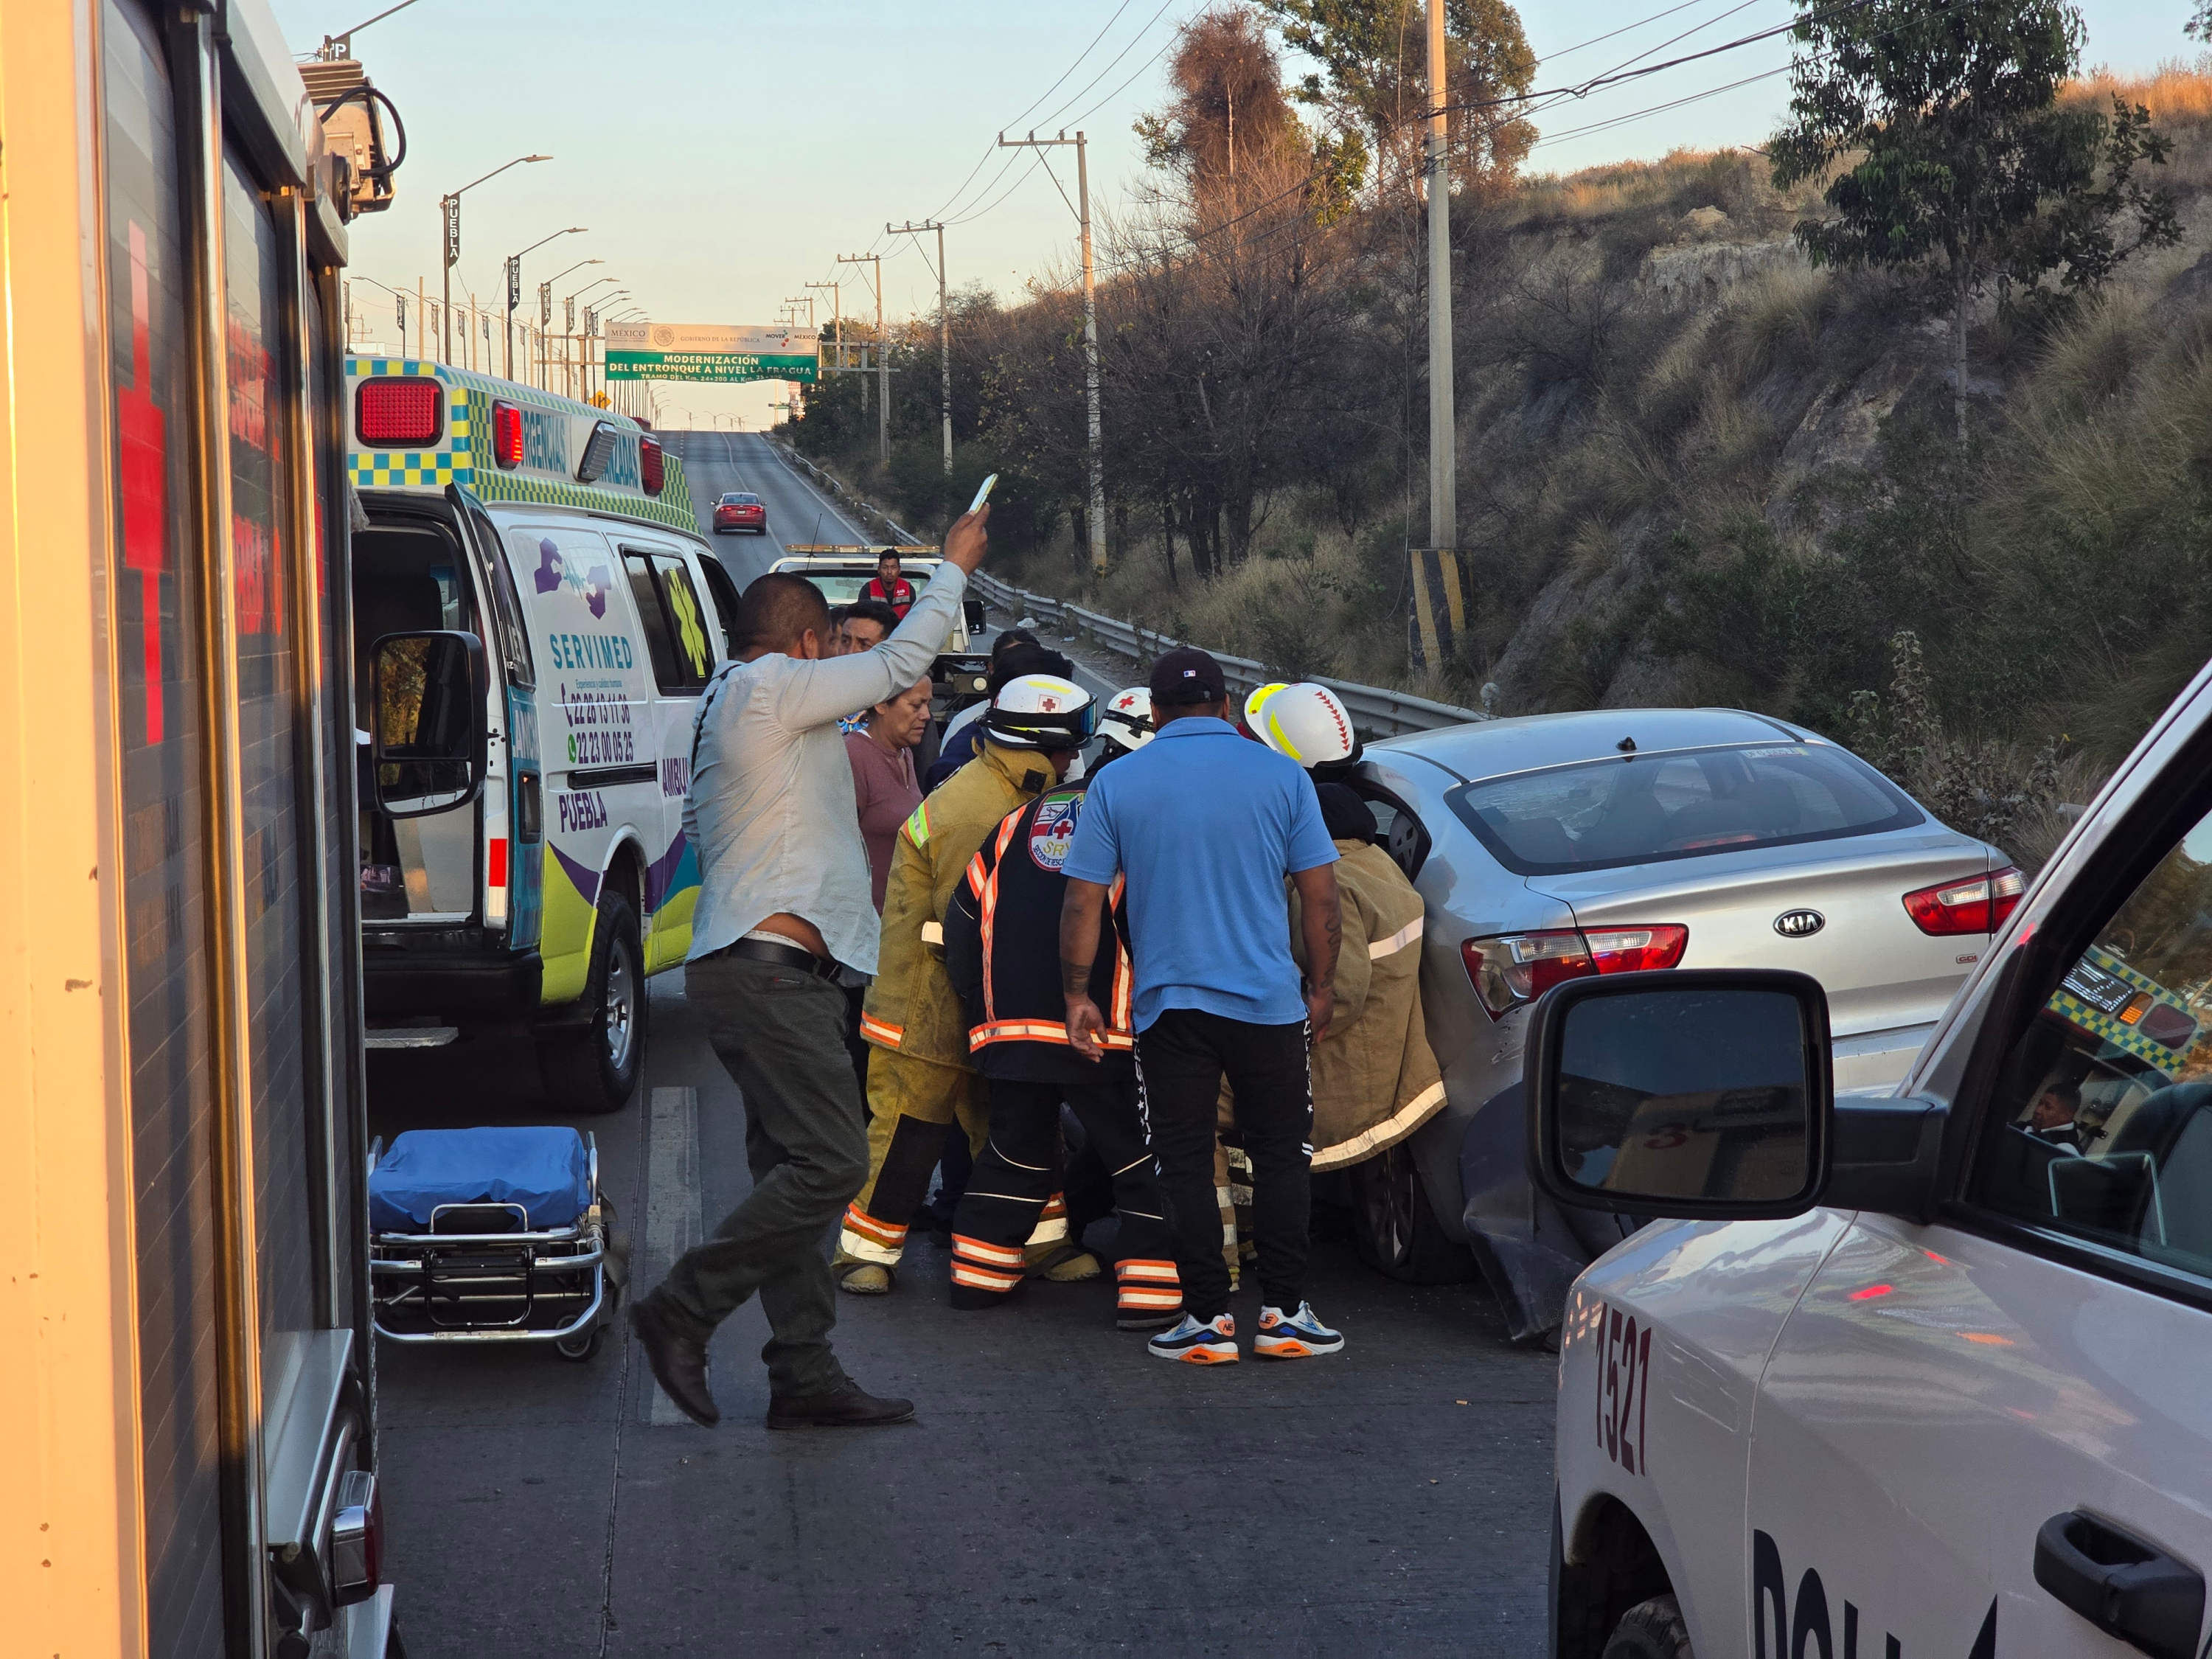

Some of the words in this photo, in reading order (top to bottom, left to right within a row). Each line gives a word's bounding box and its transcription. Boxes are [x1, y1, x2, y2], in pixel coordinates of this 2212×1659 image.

[449, 199, 459, 257] PUEBLA
[609, 363, 630, 372] DEL
[633, 364, 701, 374] ENTRONQUE
[704, 366, 712, 374] A
[715, 366, 747, 375] NIVEL
[767, 366, 811, 375] FRAGUA
[664, 355, 759, 364] MODERNIZACIÓN
[549, 633, 633, 669] SERVIMED
[571, 693, 585, 724] 22
[576, 731, 589, 764] 22
[588, 731, 600, 764] 23
[601, 731, 612, 762] 00
[612, 731, 623, 762] 05
[623, 731, 633, 762] 25
[558, 791, 608, 833] PUEBLA
[1783, 914, 1818, 933] KIA
[1596, 1301, 1652, 1478] 1521
